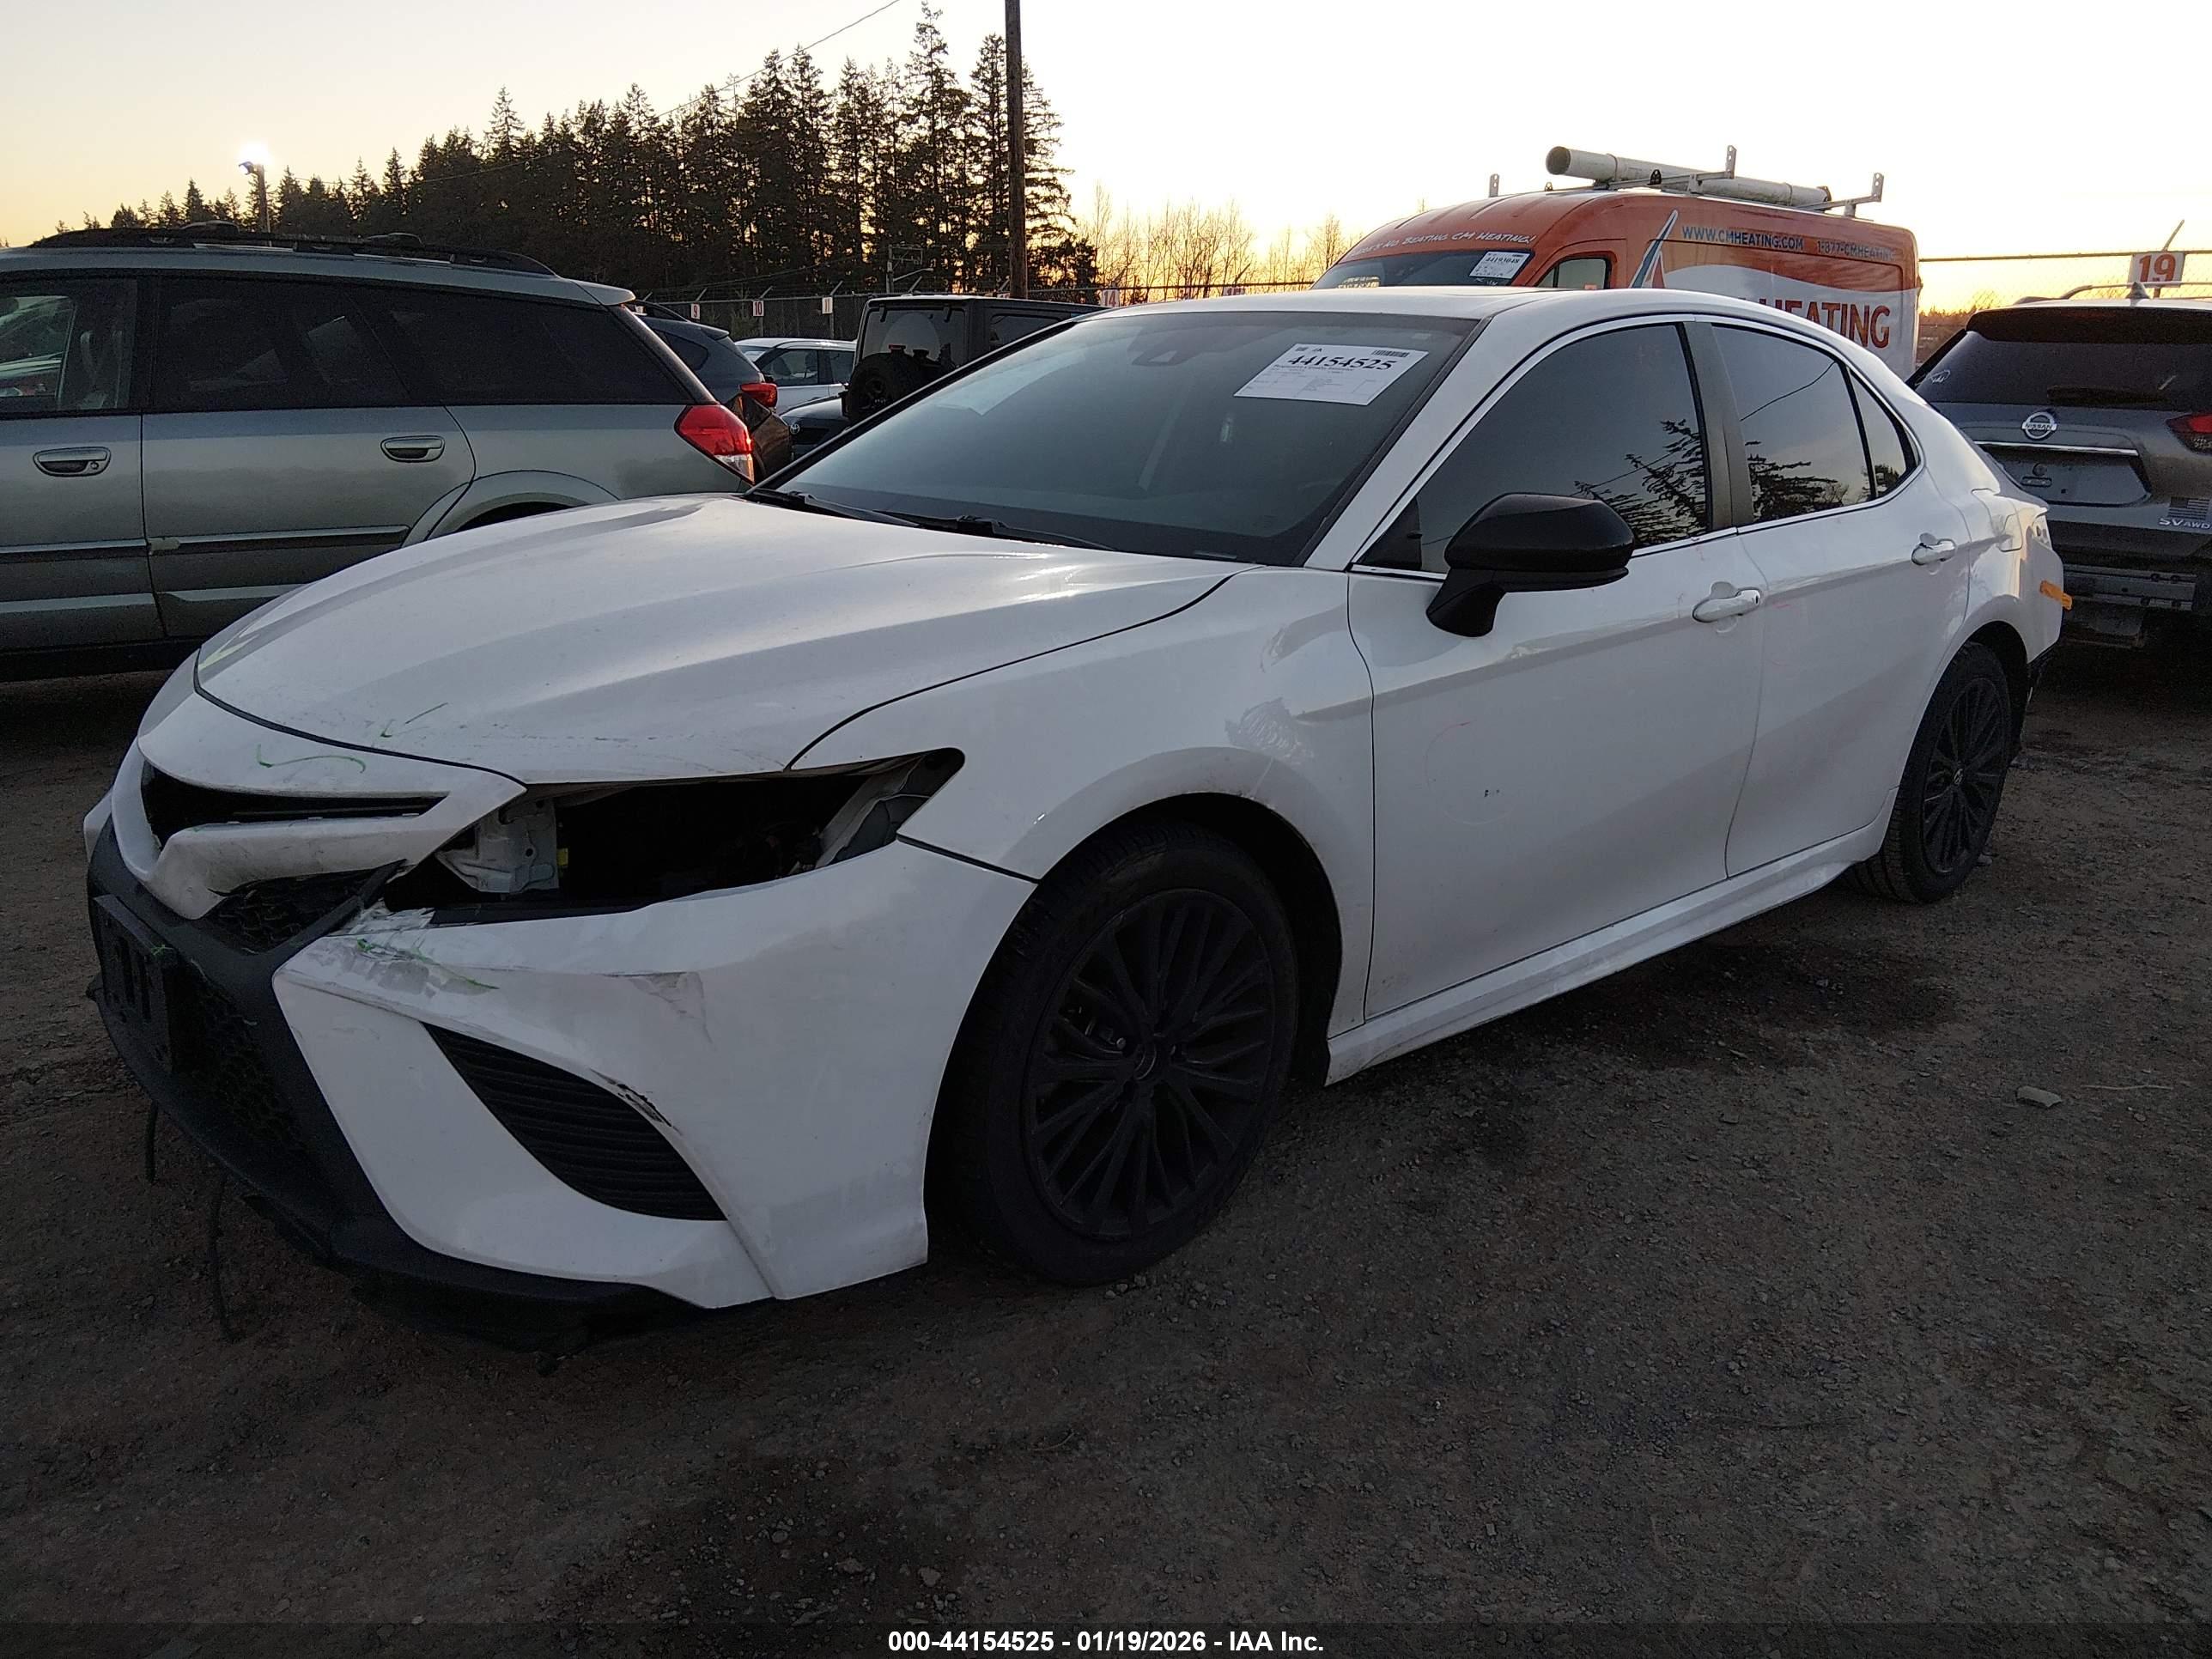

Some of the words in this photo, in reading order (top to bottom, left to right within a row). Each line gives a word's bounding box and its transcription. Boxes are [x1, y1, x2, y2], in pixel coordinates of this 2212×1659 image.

[1402, 233, 1449, 245] BEATING
[1451, 231, 1476, 240] CM
[1476, 231, 1537, 244] HEATING!
[1681, 225, 1804, 251] WWW.CMHEATING.COM
[2139, 253, 2176, 282] 19
[823, 298, 830, 312] 11
[1103, 290, 1116, 307] 14
[693, 305, 698, 318] 9
[755, 301, 763, 315] 10
[1288, 355, 1397, 370] 44154525
[2159, 517, 2185, 526] SV
